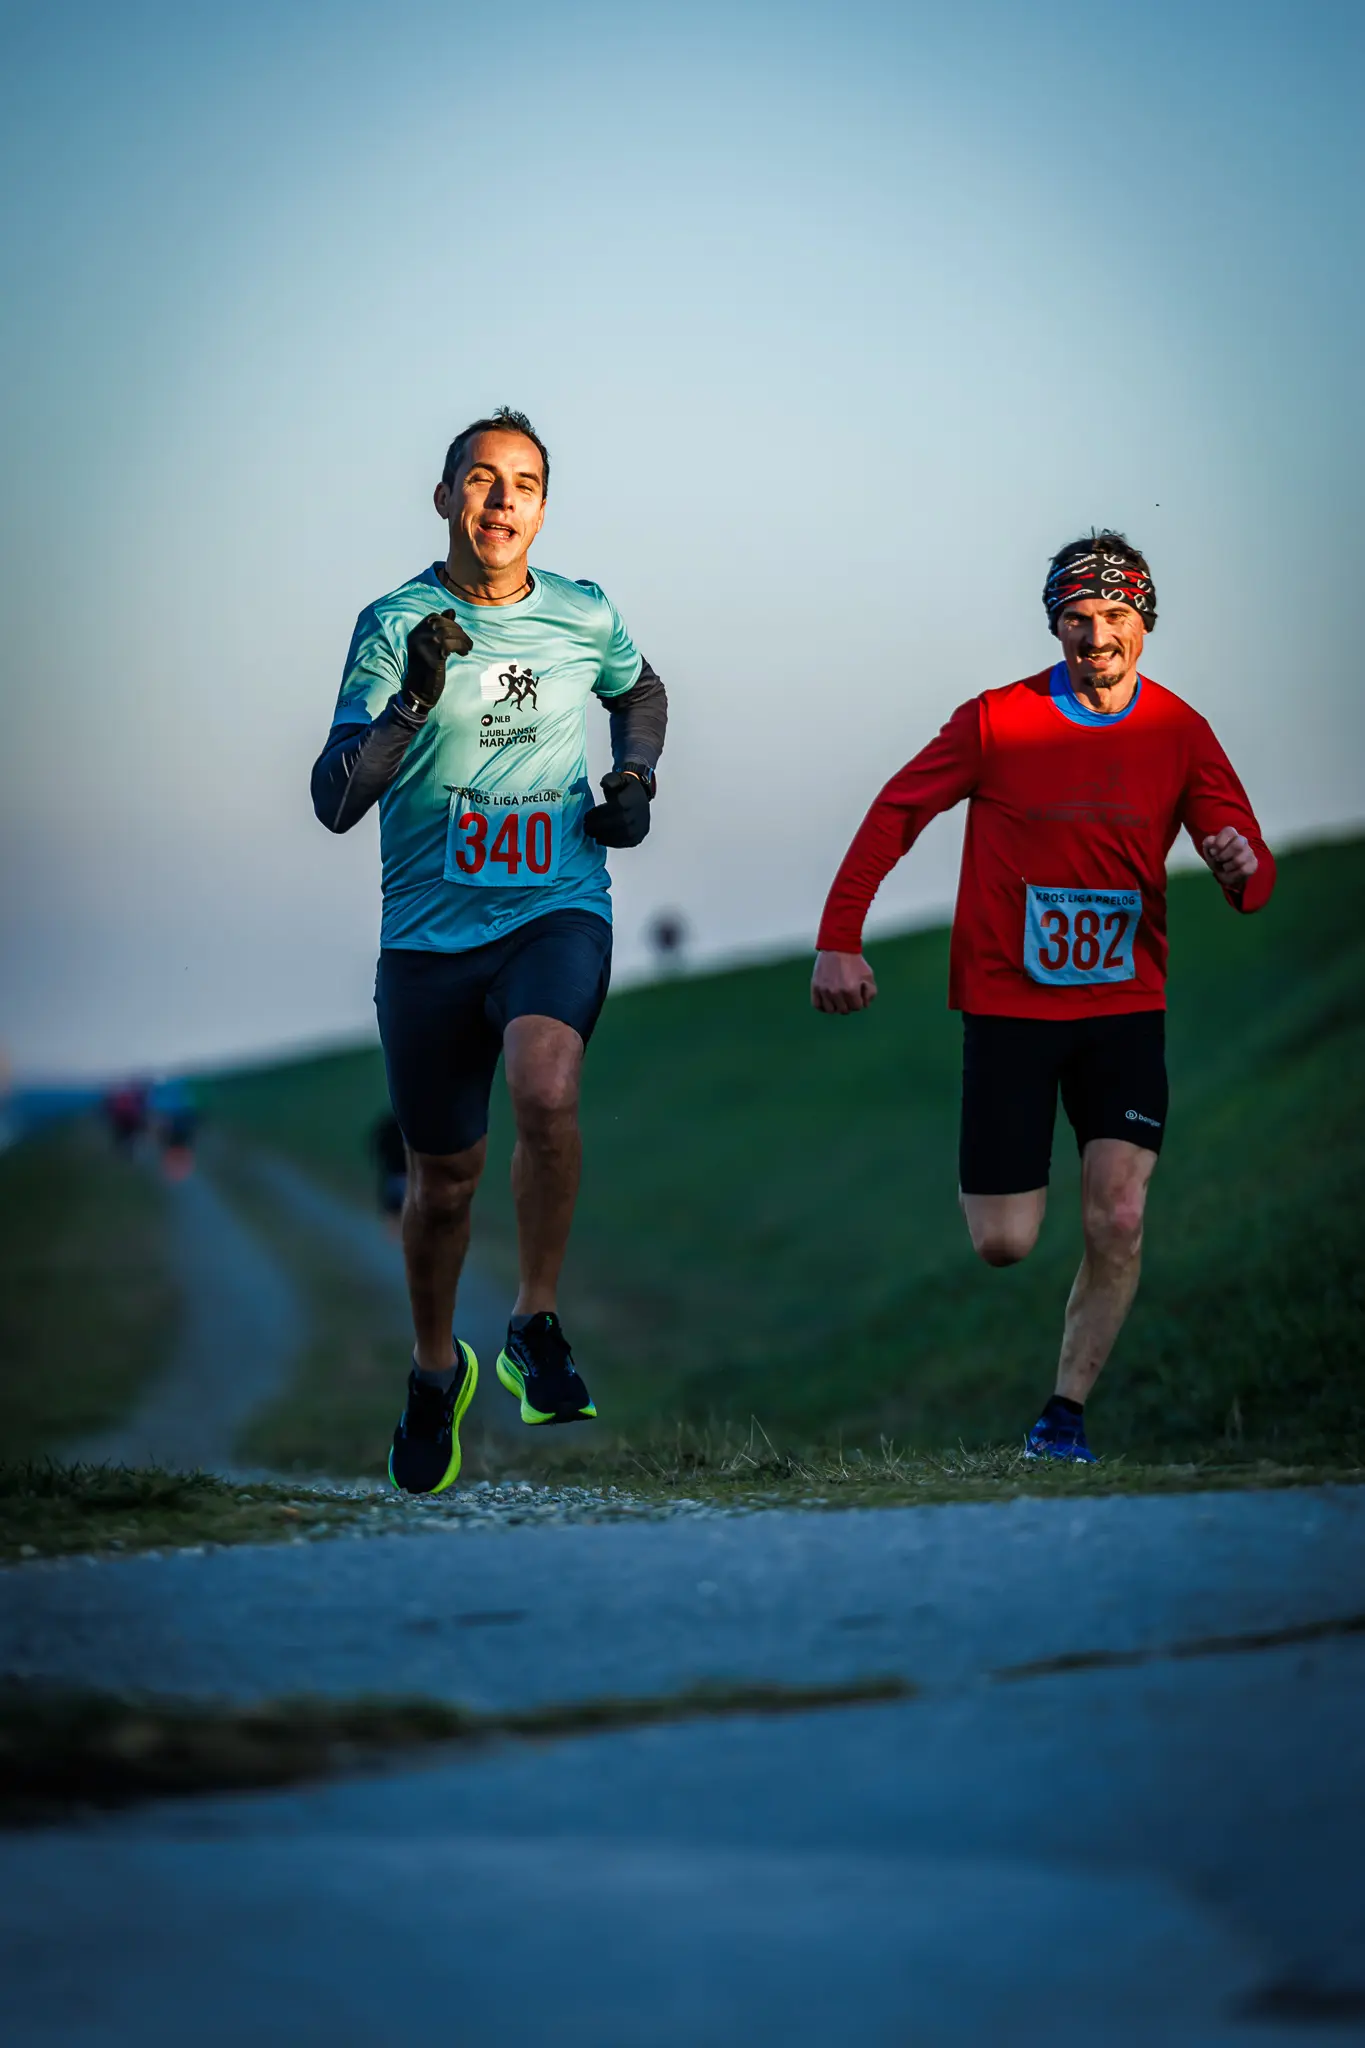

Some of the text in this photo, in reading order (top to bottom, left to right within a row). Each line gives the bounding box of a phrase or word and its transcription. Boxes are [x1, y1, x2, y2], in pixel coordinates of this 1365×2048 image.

[480, 726, 537, 737] LJUBLJANSKI
[480, 734, 536, 747] MARATON
[460, 788, 490, 805] KROS
[493, 796, 520, 806] LIGA
[456, 812, 552, 874] 340
[1036, 892, 1136, 905] KROS LIGA PRELOG
[1039, 909, 1130, 971] 382
